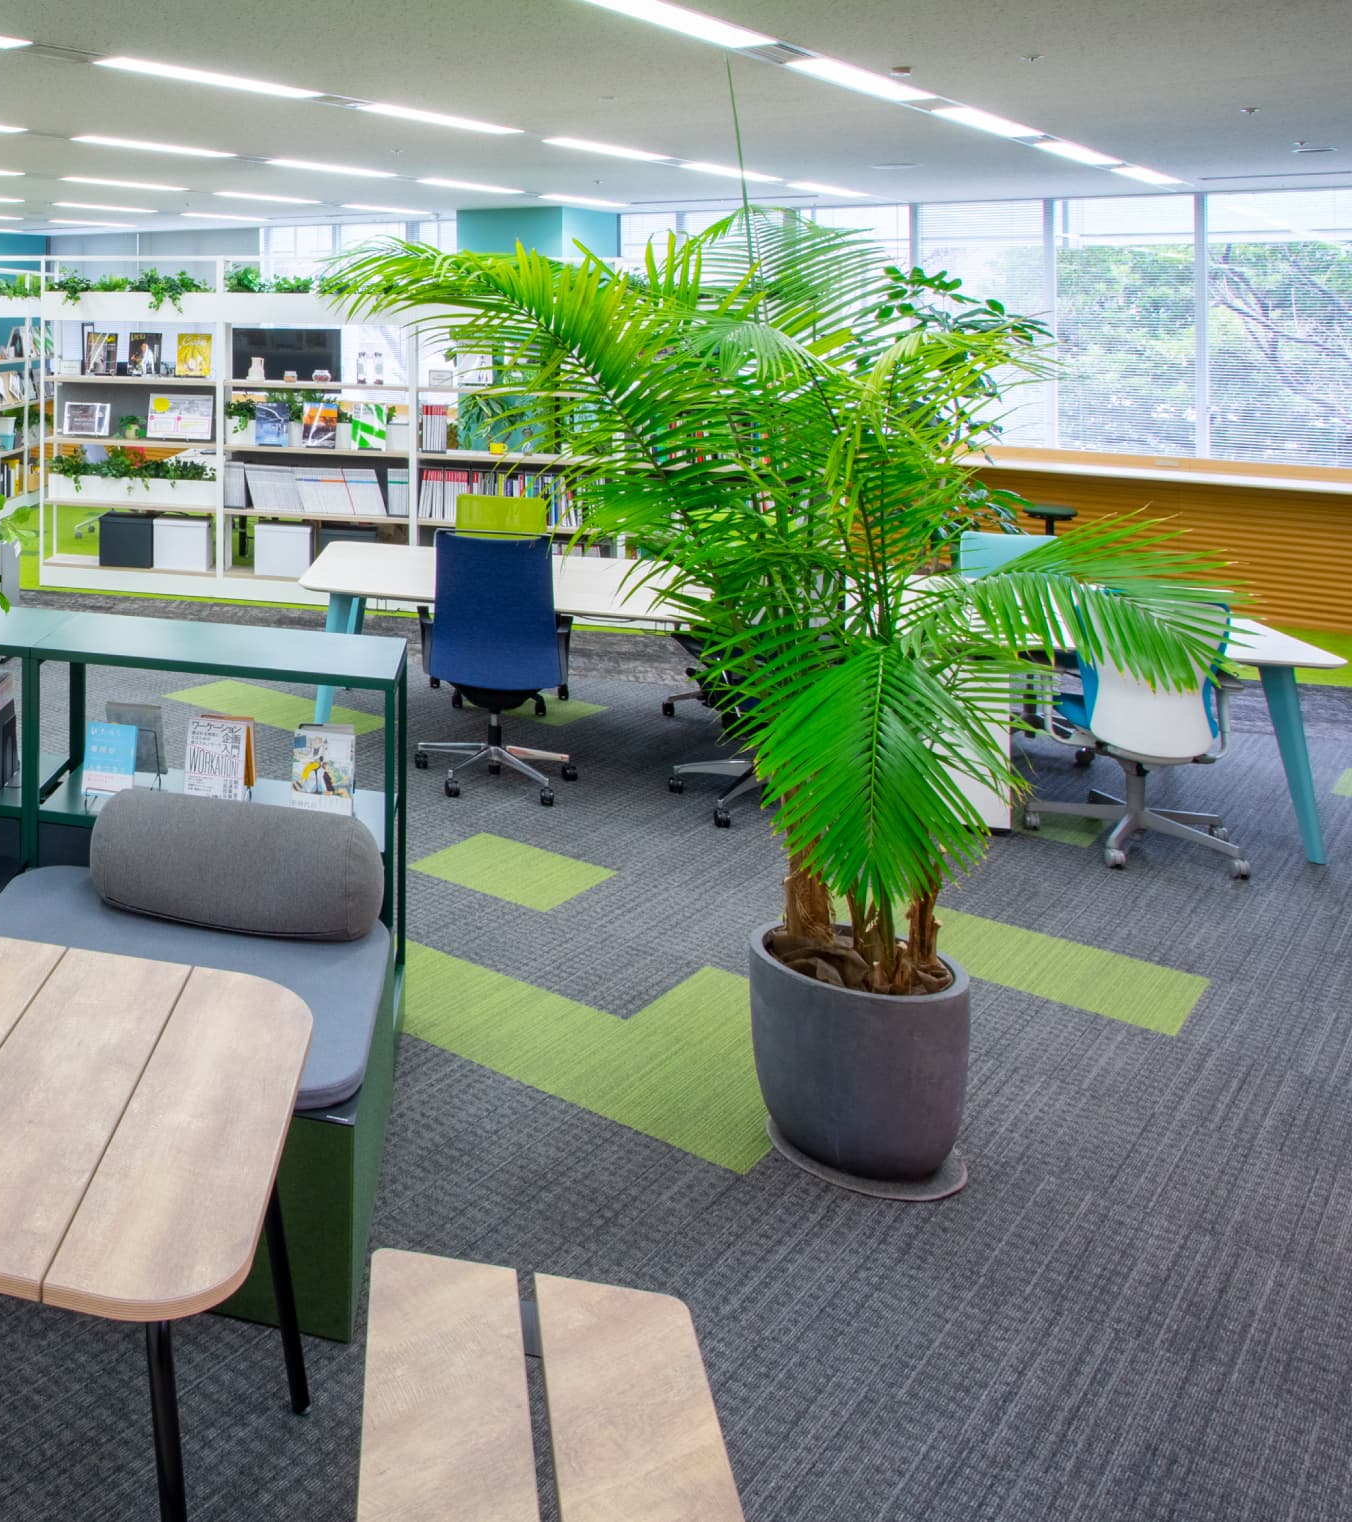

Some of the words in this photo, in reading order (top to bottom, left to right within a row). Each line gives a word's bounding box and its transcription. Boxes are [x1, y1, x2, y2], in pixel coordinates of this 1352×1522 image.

[191, 721, 242, 734] ワーケーション
